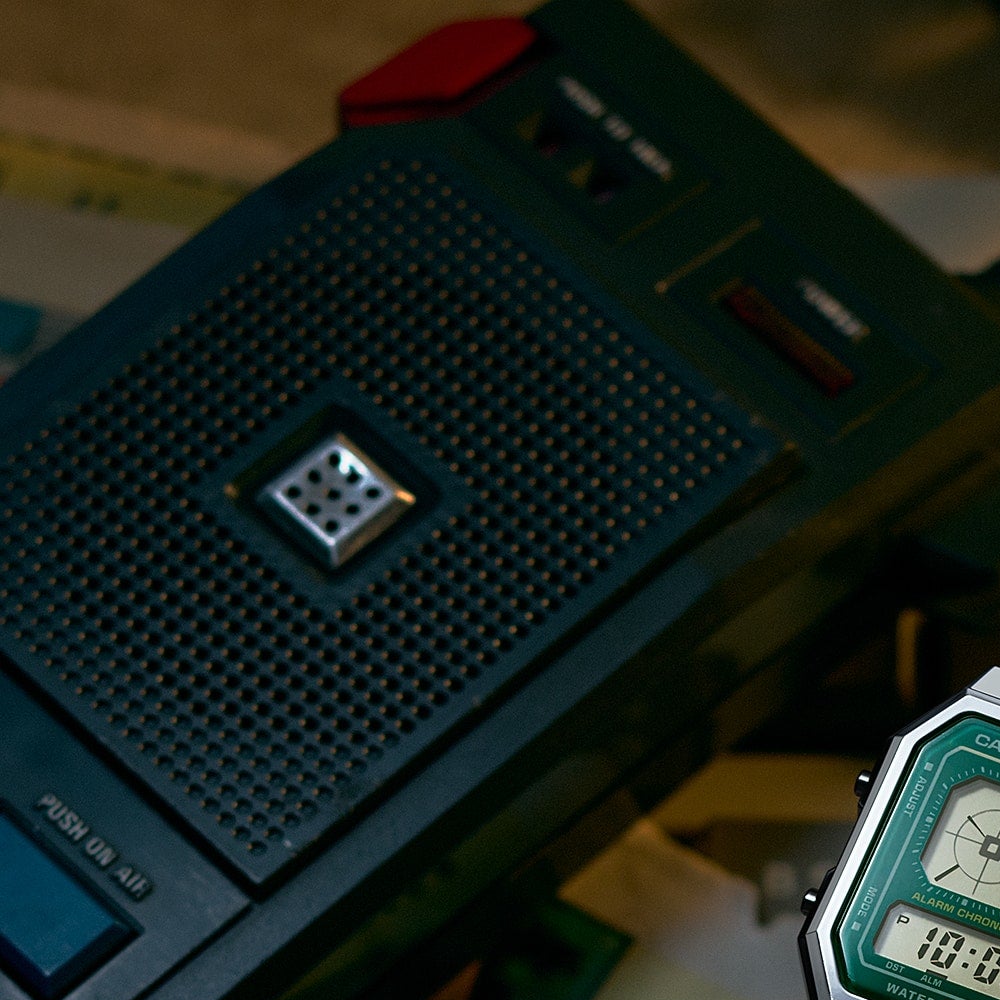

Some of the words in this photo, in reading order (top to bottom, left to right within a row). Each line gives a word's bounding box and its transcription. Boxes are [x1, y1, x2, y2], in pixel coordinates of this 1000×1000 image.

[904, 775, 927, 818] ADJUST
[38, 793, 91, 841] PUSH
[85, 837, 118, 867] ON
[113, 865, 148, 899] AIR
[857, 886, 878, 917] MODE
[911, 891, 955, 912] ALARM
[896, 914, 910, 925] P
[885, 961, 906, 974] DST
[920, 974, 943, 988] ALM
